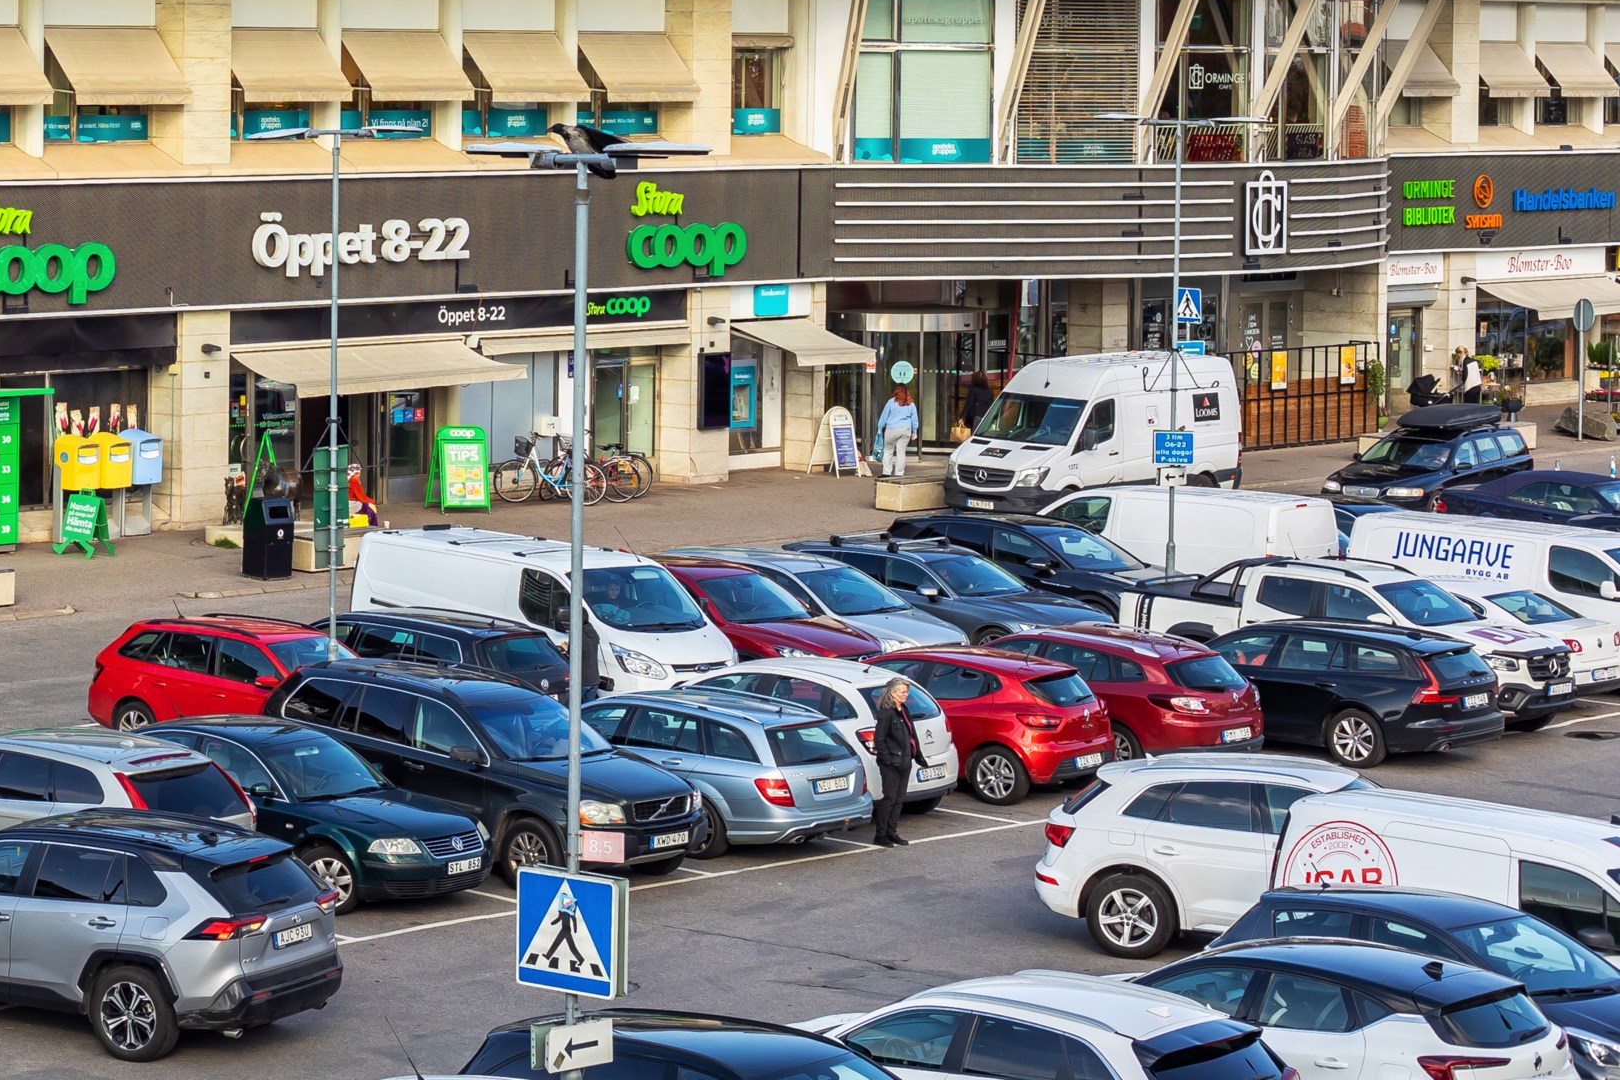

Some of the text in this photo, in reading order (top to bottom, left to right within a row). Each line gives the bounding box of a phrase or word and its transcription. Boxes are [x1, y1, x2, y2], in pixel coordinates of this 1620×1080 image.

[1205, 72, 1245, 84] ORMINGE
[1403, 179, 1456, 200] ORMINGE
[631, 181, 684, 217] Stora
[1513, 187, 1616, 212] Handelsbanken
[1403, 206, 1456, 226] BIBLIOTEK
[1464, 214, 1503, 229] SYNSAM
[252, 212, 470, 277] Öppet 8-22
[626, 222, 747, 277] coop
[1389, 259, 1437, 277] Blomster-Boo
[1508, 251, 1572, 274] Blomster-Boo
[586, 296, 651, 317] Stora coop
[438, 306, 506, 326] Öppet 8-22
[1196, 408, 1218, 418] LOOMIS
[1, 435, 12, 445] 30
[450, 429, 475, 439] coop
[449, 450, 479, 461] TIPS
[1, 494, 12, 504] 36
[69, 502, 96, 513] Handlat
[66, 516, 93, 529] Hämta
[1392, 531, 1515, 569] JUNGARVE
[1465, 568, 1509, 580] BYGG AB
[818, 780, 832, 790] NEU
[655, 832, 686, 846] XWD 470
[1310, 831, 1367, 849] ESTABLISHED
[1328, 841, 1349, 851] 2008
[449, 856, 481, 873] STL 852
[280, 925, 310, 944] AJC 93U
